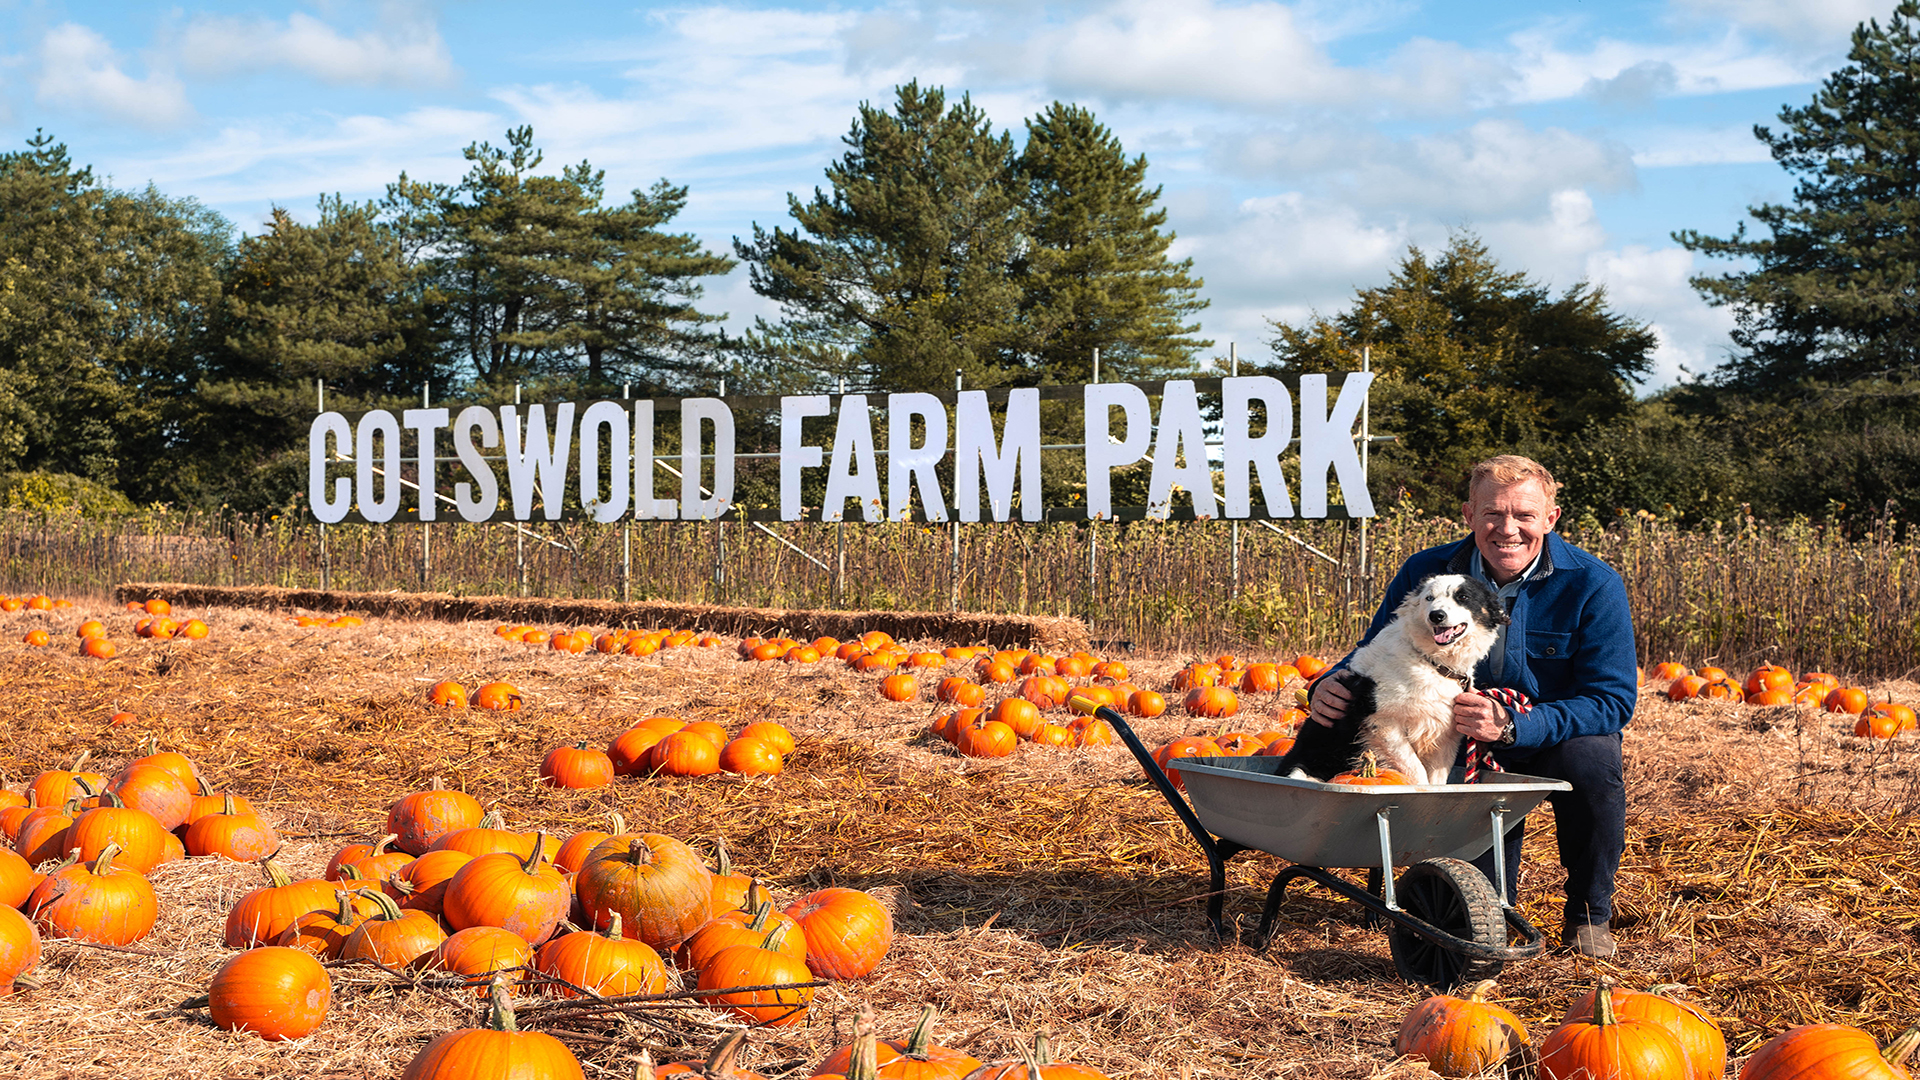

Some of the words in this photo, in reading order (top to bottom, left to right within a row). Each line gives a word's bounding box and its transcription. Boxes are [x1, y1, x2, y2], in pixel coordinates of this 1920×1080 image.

[309, 398, 735, 523] COTSWOLD
[780, 388, 1042, 522] FARM
[1085, 372, 1376, 520] PARK
